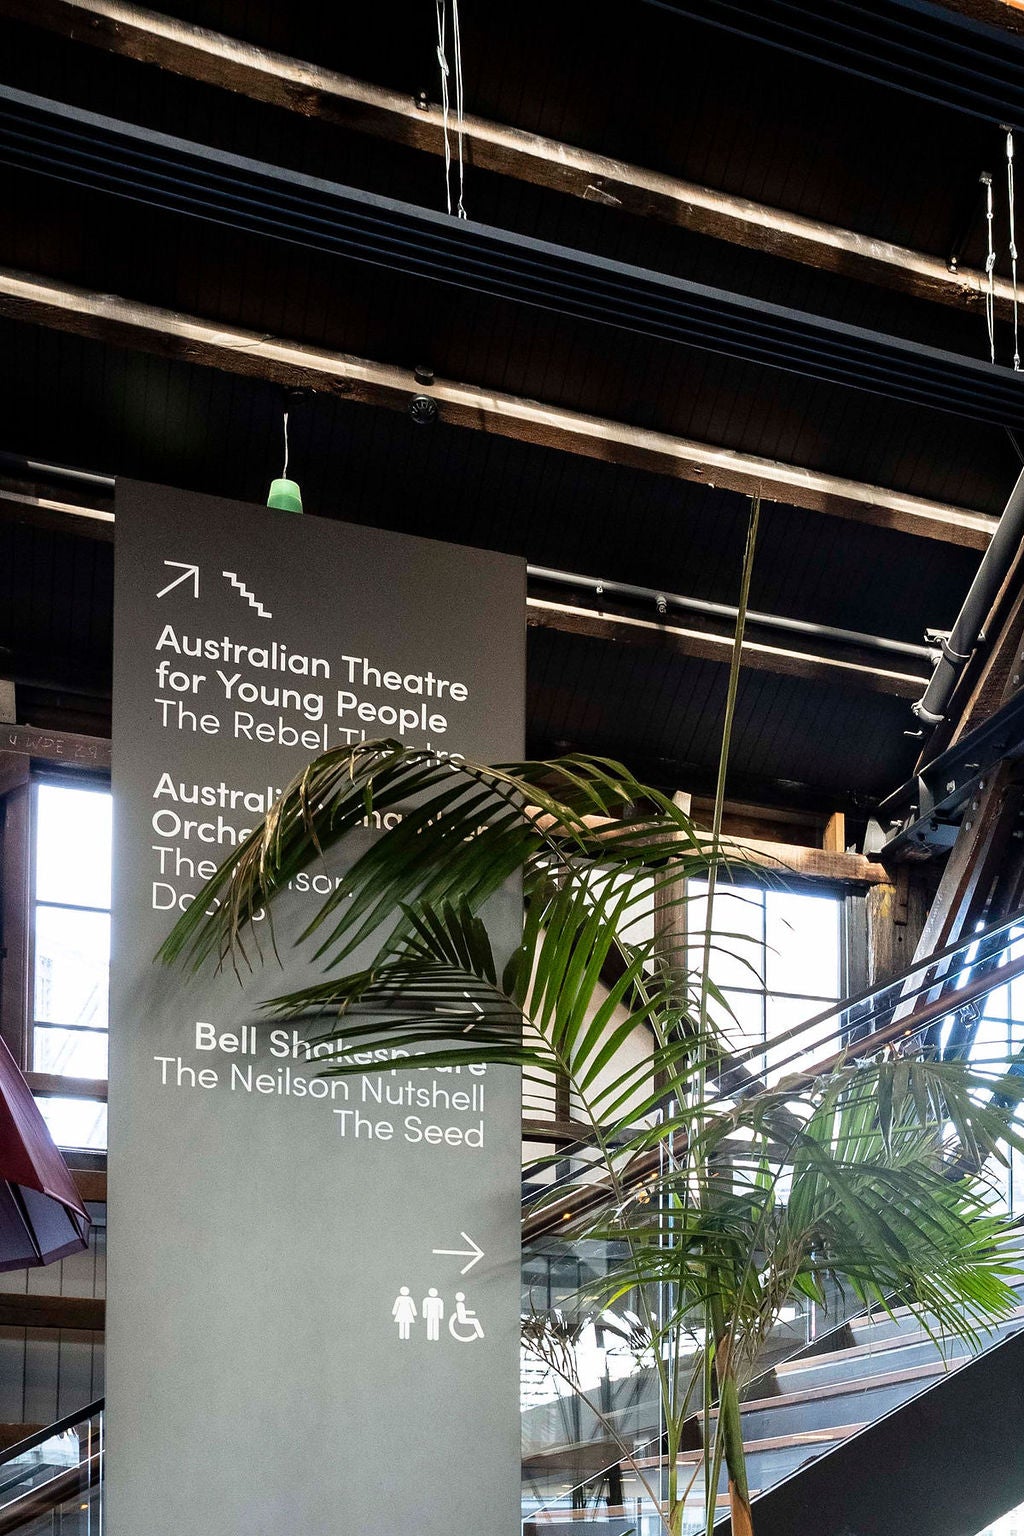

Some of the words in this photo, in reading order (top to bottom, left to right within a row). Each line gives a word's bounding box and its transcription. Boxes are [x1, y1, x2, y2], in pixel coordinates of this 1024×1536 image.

[155, 624, 331, 679] Australian
[341, 655, 469, 701] Theatre
[155, 661, 206, 694] for
[216, 670, 324, 721] Young
[337, 691, 448, 735] People
[154, 698, 220, 735] The
[233, 711, 328, 752] Rebel
[152, 772, 324, 819] Austral
[151, 809, 254, 847] Orche
[151, 845, 218, 881] The
[195, 1022, 257, 1058] Bell
[153, 1056, 219, 1089] The
[230, 1064, 349, 1100] Neilson
[361, 1075, 485, 1112] Nutshell
[333, 1109, 394, 1142] The
[404, 1116, 485, 1148] Seed
